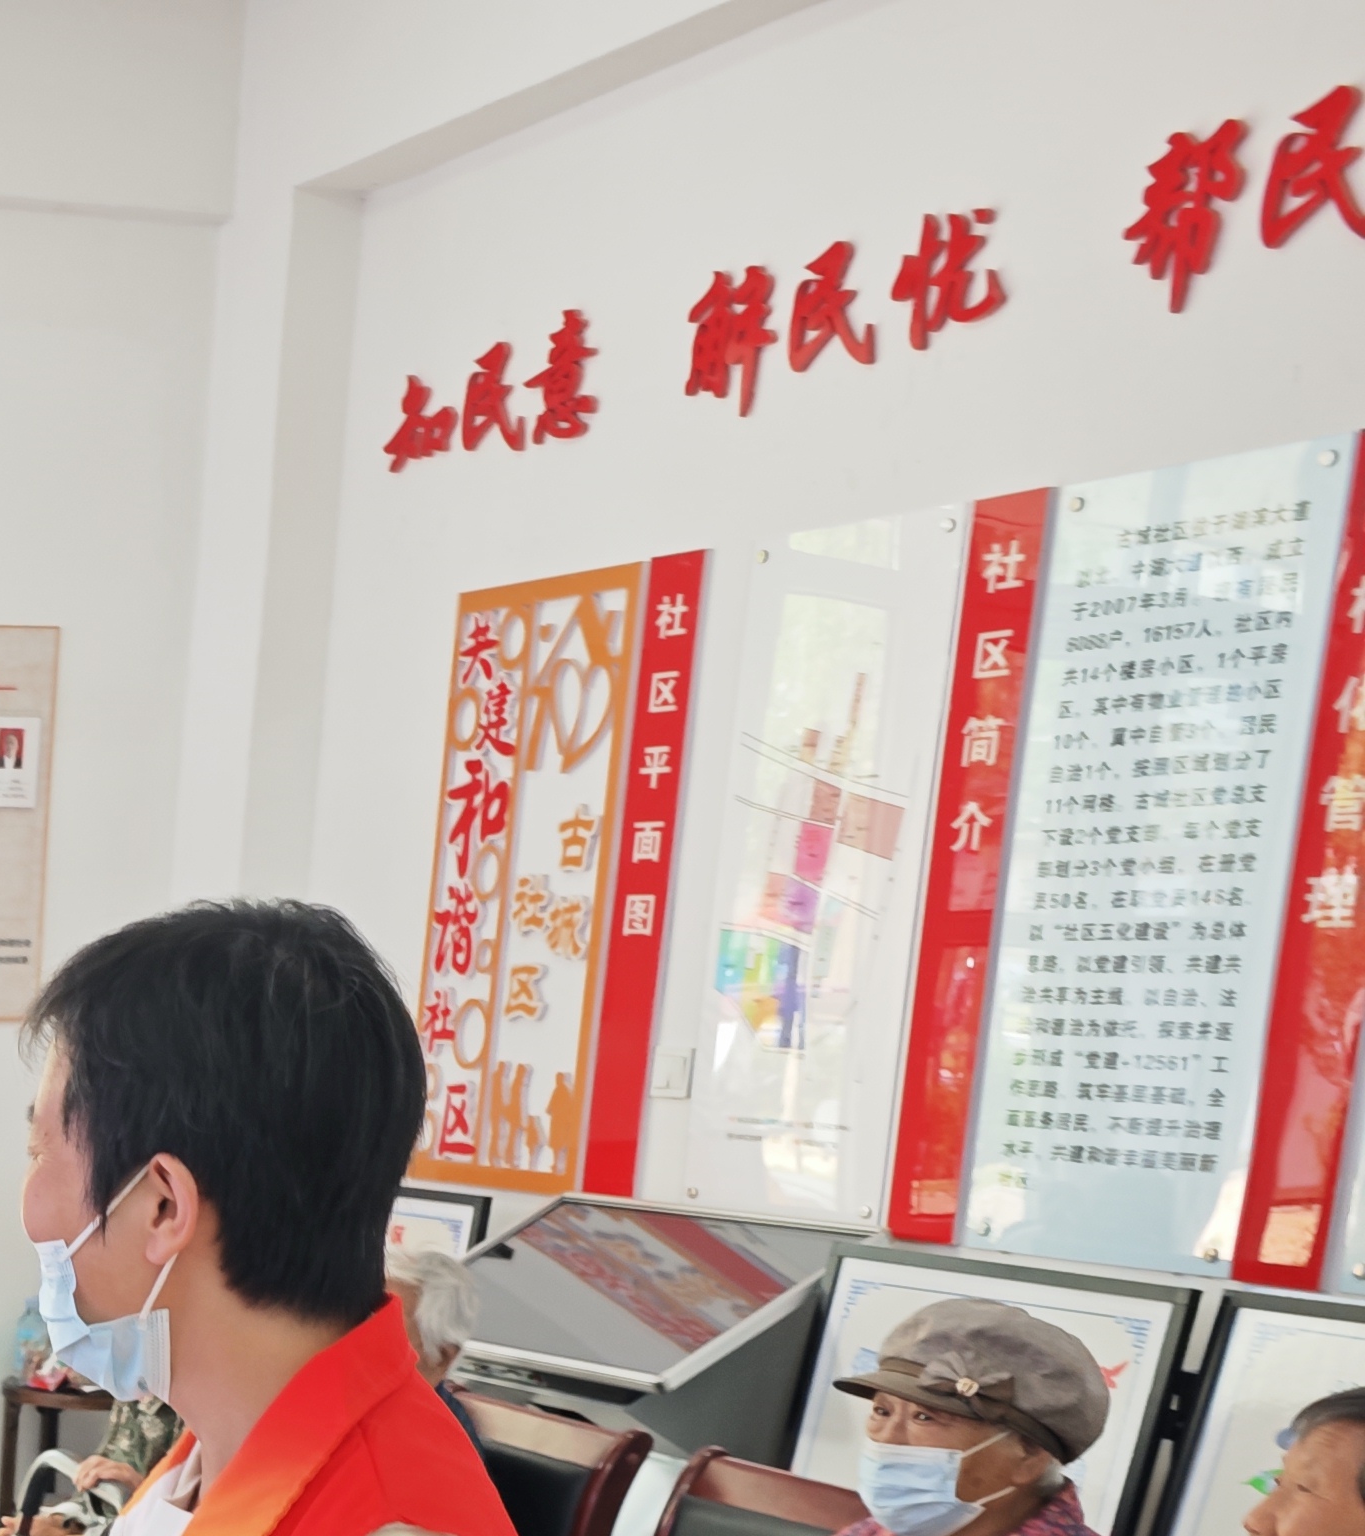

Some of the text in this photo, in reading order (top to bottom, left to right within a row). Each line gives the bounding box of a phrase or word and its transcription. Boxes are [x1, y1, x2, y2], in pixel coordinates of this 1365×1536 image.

[384, 84, 1365, 474] 知民意 解民忧 帮民
[622, 594, 688, 937] 社区平面图
[950, 539, 1027, 851] 社区简介
[423, 612, 518, 1160] 共建和谐社区
